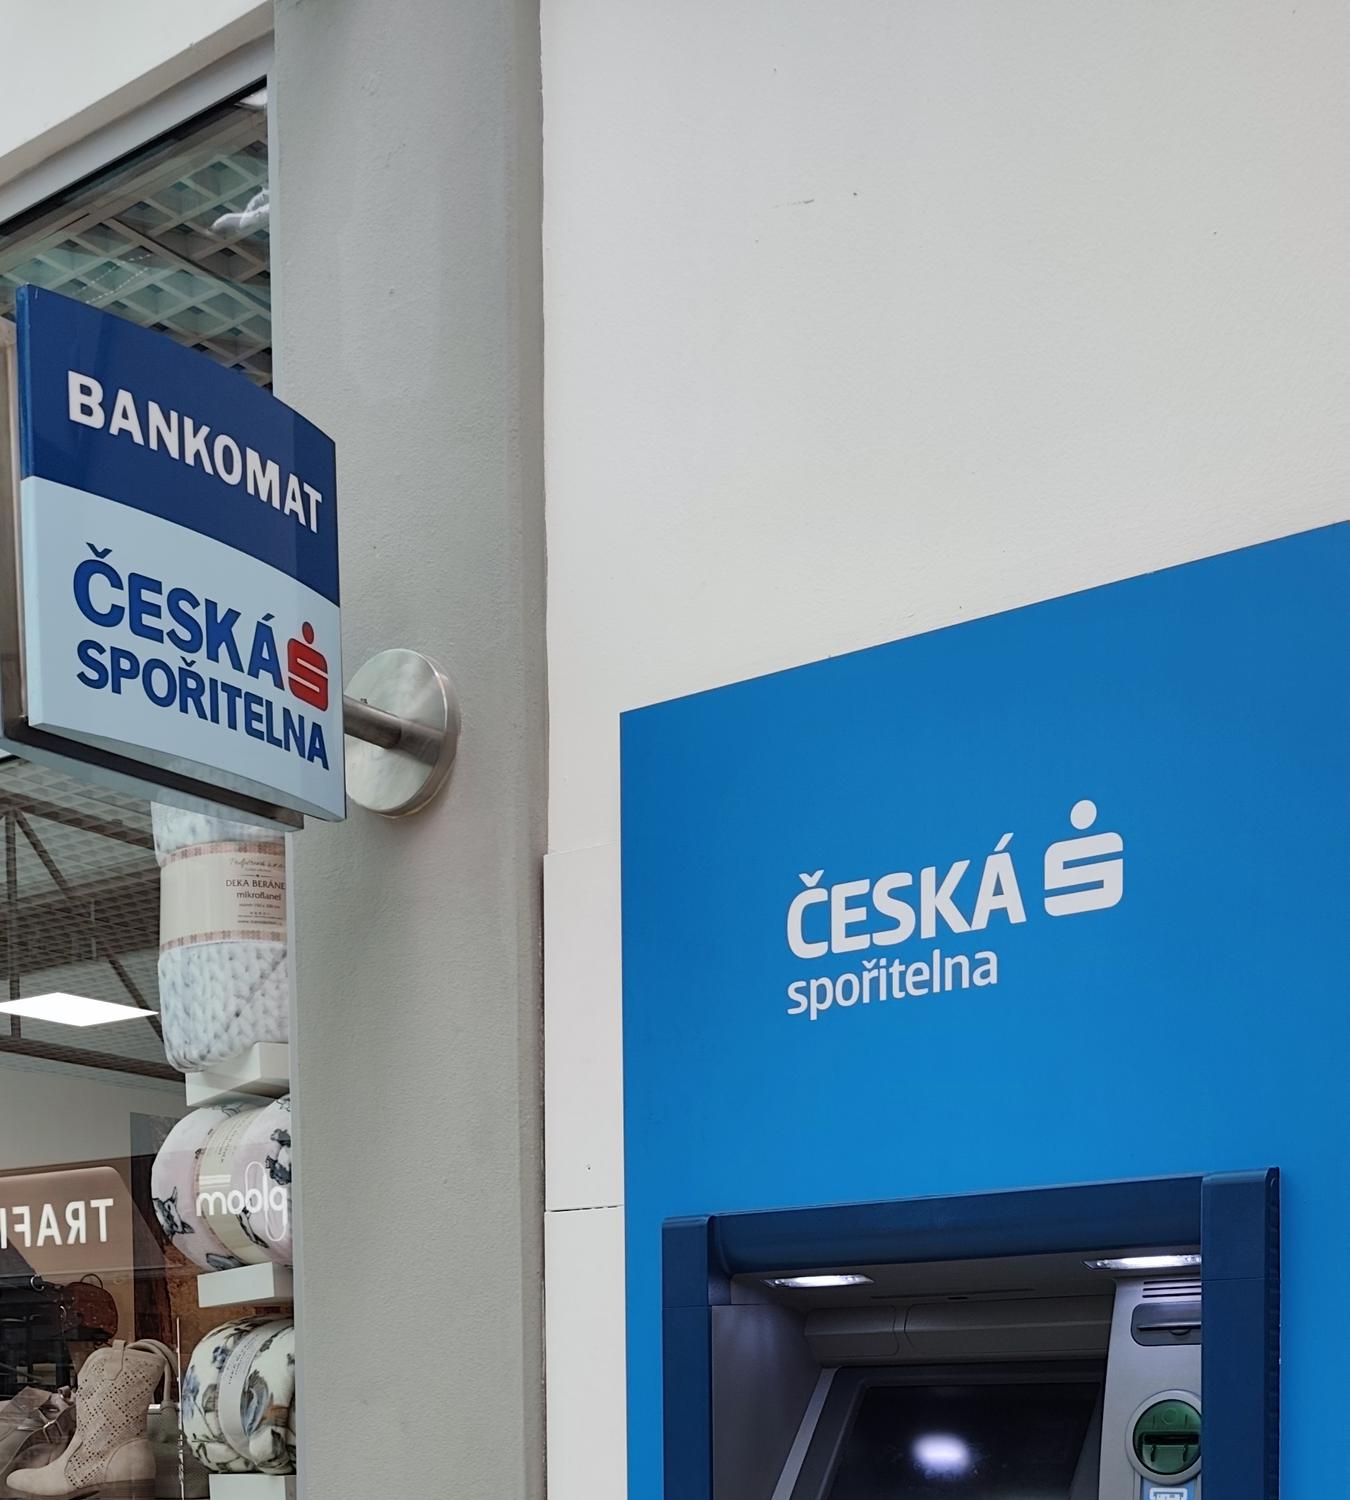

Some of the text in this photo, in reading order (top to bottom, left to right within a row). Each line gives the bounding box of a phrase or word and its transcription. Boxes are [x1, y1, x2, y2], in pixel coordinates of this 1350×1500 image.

[67, 370, 323, 534] BANKOMAT
[72, 542, 286, 691] ČESKÁ
[76, 638, 330, 771] SPOŘITELNA
[226, 880, 250, 888] DEKA
[786, 832, 1027, 959] ČESKÁ
[786, 949, 998, 1021] spořitelna
